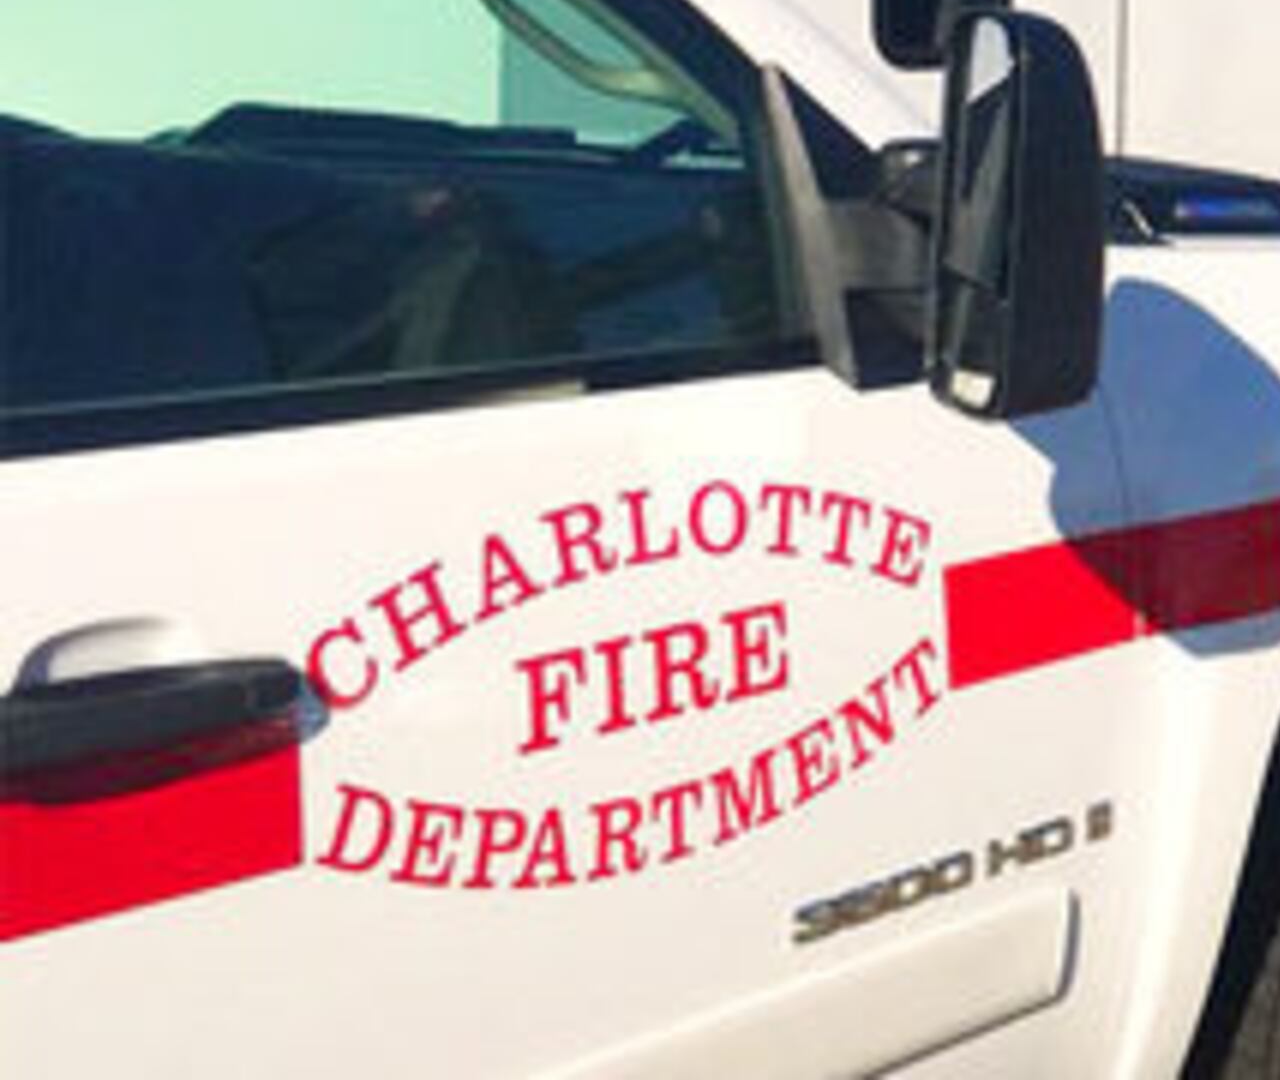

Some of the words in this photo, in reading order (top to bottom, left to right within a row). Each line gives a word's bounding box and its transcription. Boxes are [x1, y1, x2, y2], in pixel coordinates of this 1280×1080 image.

[303, 479, 933, 711] CHARLOTTE
[514, 599, 791, 755] FIRE
[315, 637, 940, 890] DEPARTMENT
